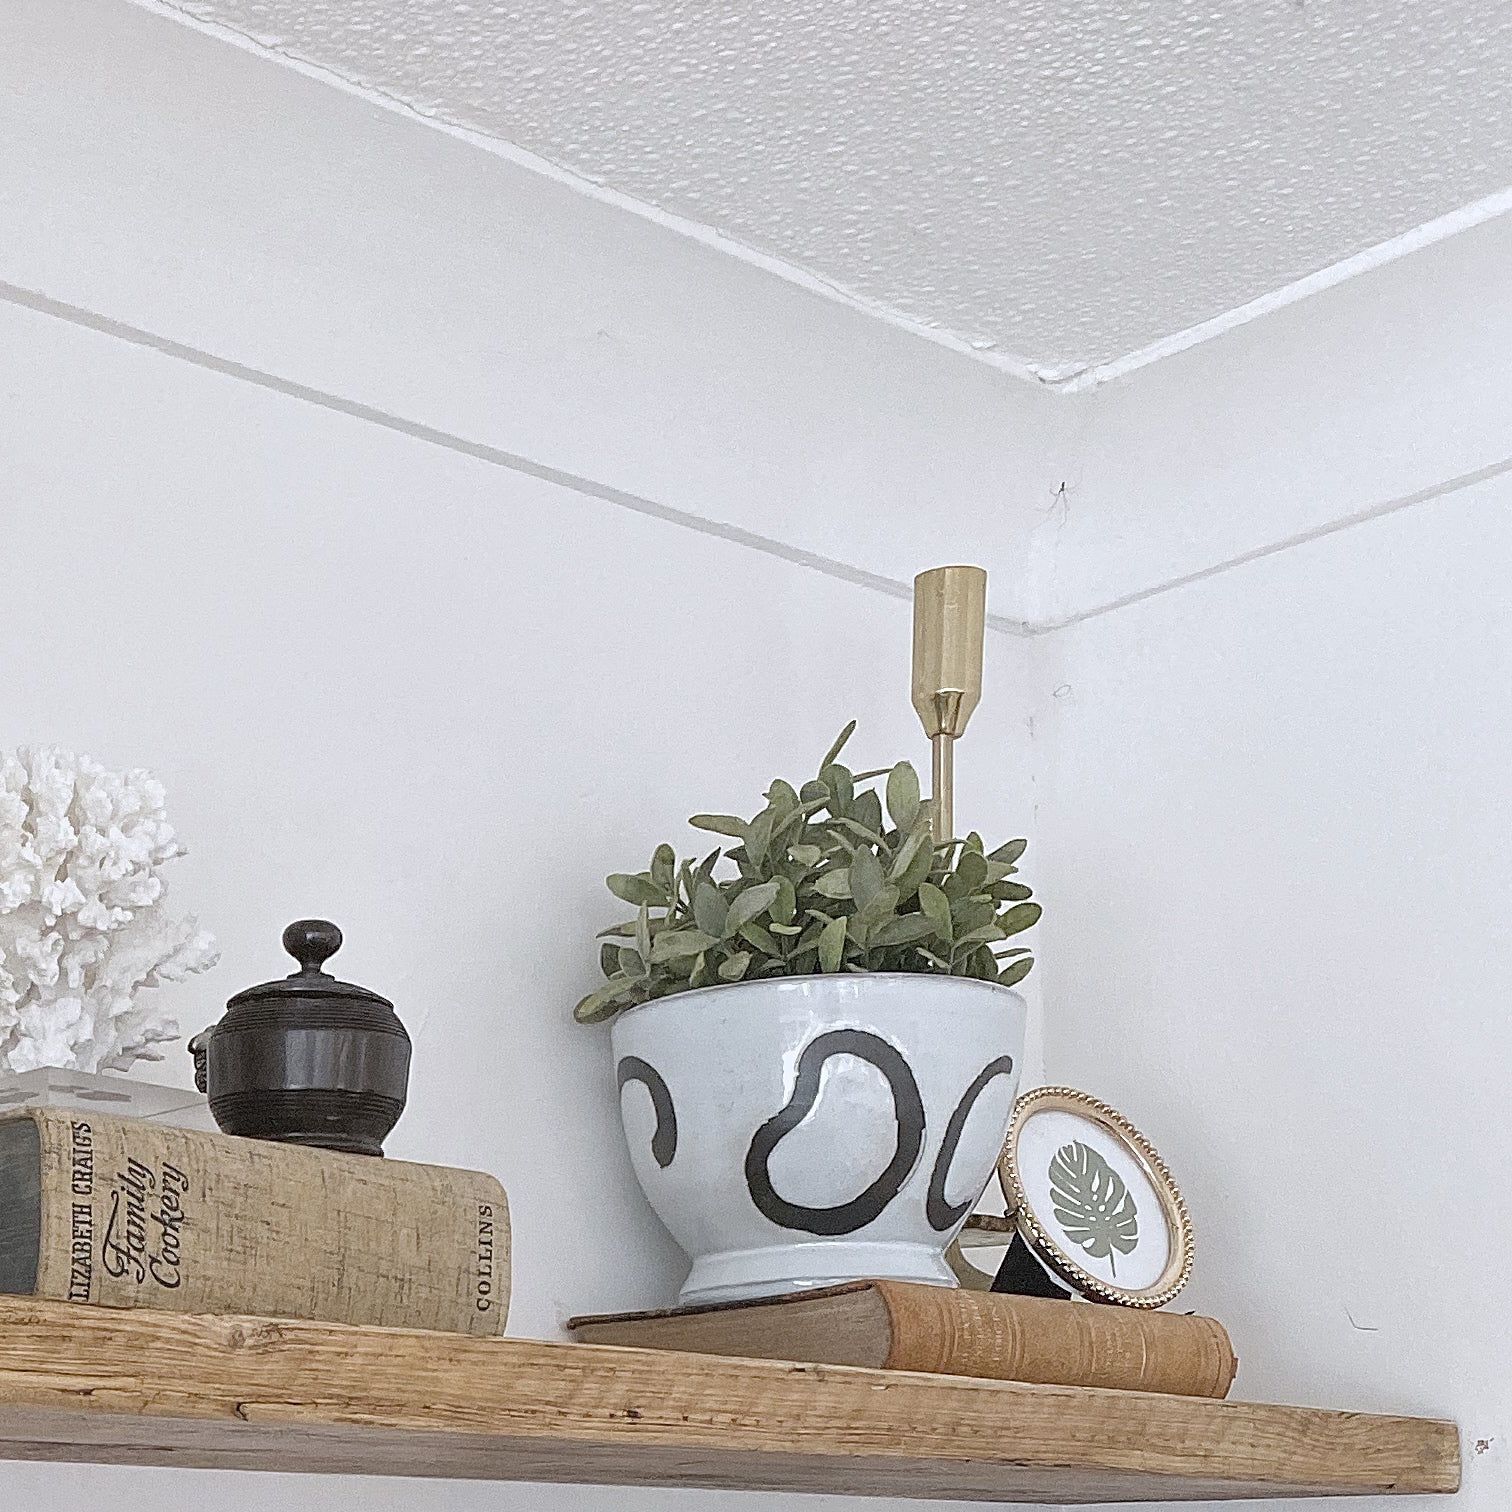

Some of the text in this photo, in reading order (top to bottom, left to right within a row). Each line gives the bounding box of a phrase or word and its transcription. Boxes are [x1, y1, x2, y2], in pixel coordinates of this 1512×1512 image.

[67, 1202, 93, 1300] LIZABETH
[102, 1156, 156, 1284] Family
[148, 1161, 189, 1289] Cookery
[476, 1205, 493, 1312] COLLINS
